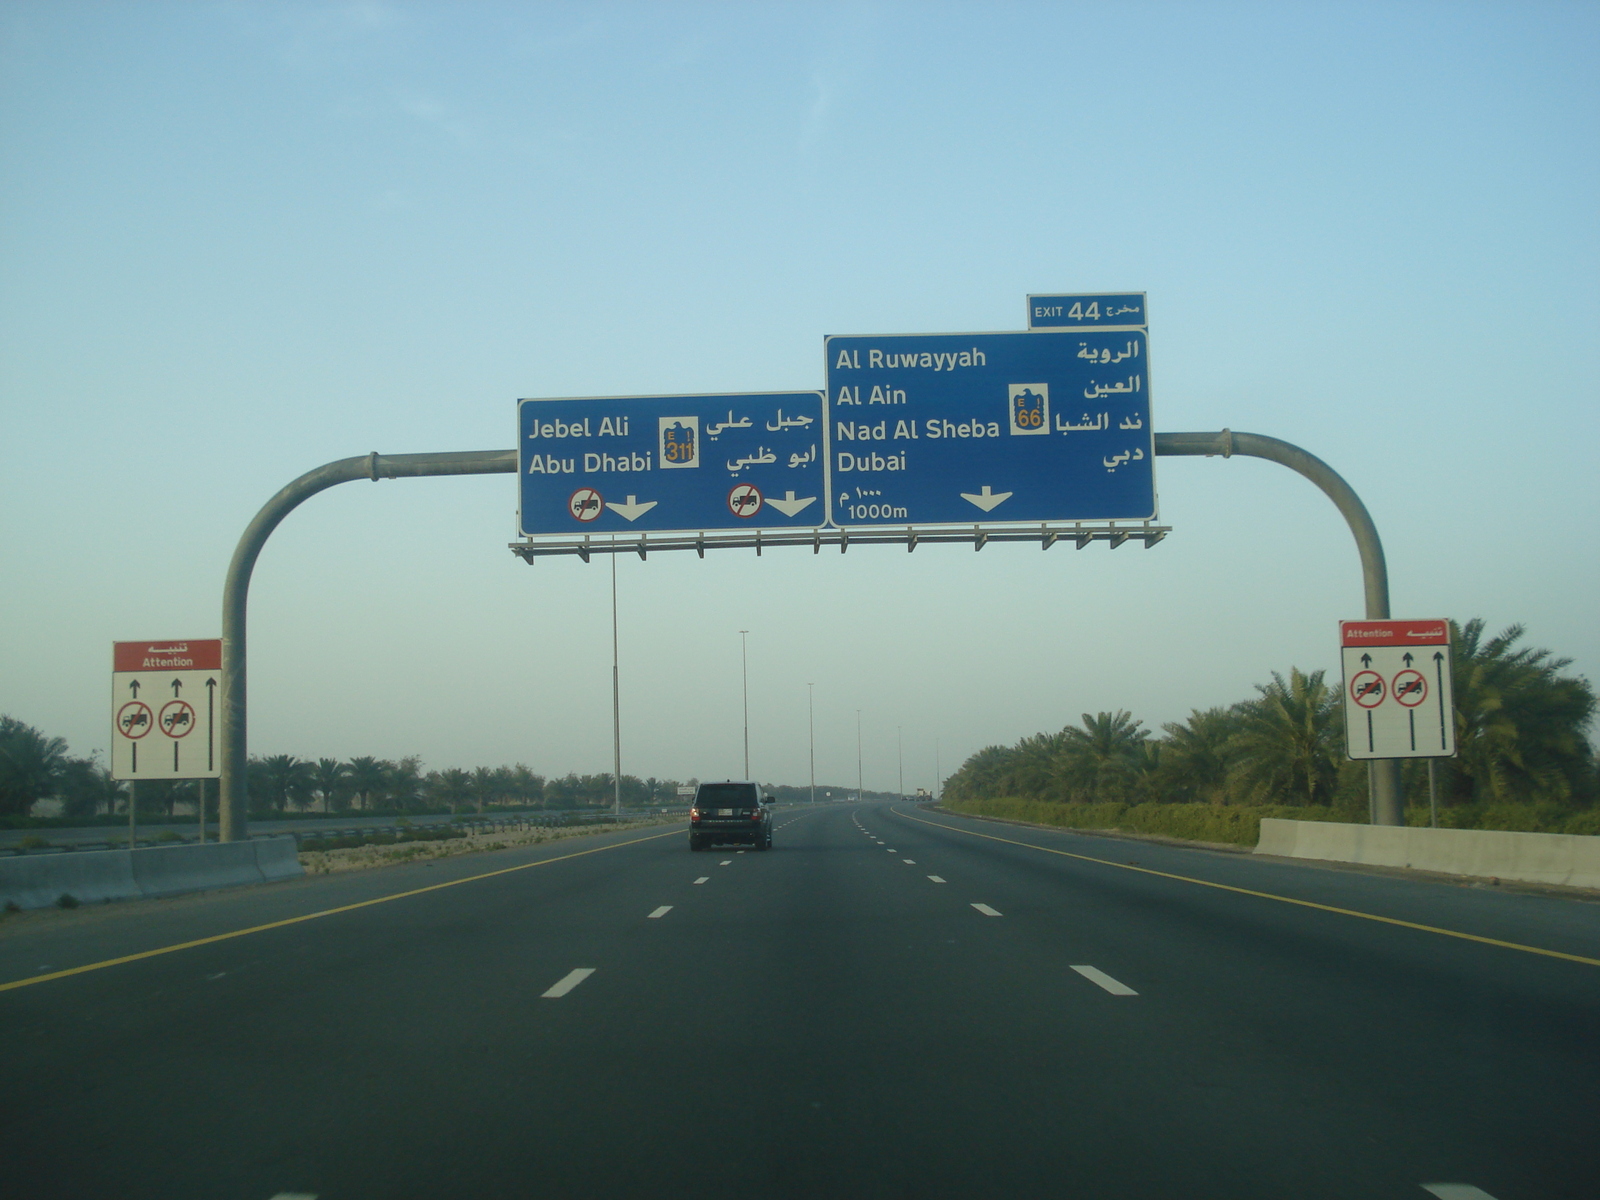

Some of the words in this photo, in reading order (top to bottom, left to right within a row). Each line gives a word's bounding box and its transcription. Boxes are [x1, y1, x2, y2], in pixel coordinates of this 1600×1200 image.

[1035, 306, 1063, 317] EXIT
[1068, 302, 1100, 321] 44
[1106, 304, 1140, 317] مخرج
[836, 349, 861, 369] Al
[869, 347, 986, 372] Ruwayyah
[1077, 340, 1139, 364] الروية
[836, 386, 862, 406] Al
[869, 385, 907, 405] Ain
[1083, 374, 1140, 399] العين
[1017, 398, 1025, 407] E
[529, 417, 591, 439] Jebel
[598, 416, 629, 437] Ali
[706, 409, 754, 442] علي
[766, 408, 814, 432] جبل
[1018, 409, 1041, 427] 66
[1056, 412, 1109, 436] الشبا
[1119, 412, 1143, 430] ند
[667, 431, 675, 440] E
[837, 420, 886, 441] Nad
[893, 419, 918, 440] Al
[926, 418, 1000, 439] Sheba
[666, 441, 693, 461] 311
[726, 446, 777, 478] ظبي
[787, 443, 816, 469] ابو
[838, 450, 906, 472] Dubai
[1103, 447, 1144, 473] دبي
[529, 454, 575, 475] Abu
[584, 451, 651, 473] Dhabi
[848, 504, 908, 520] 1000m
[1347, 629, 1393, 638] Attention
[143, 657, 193, 667] Attention
